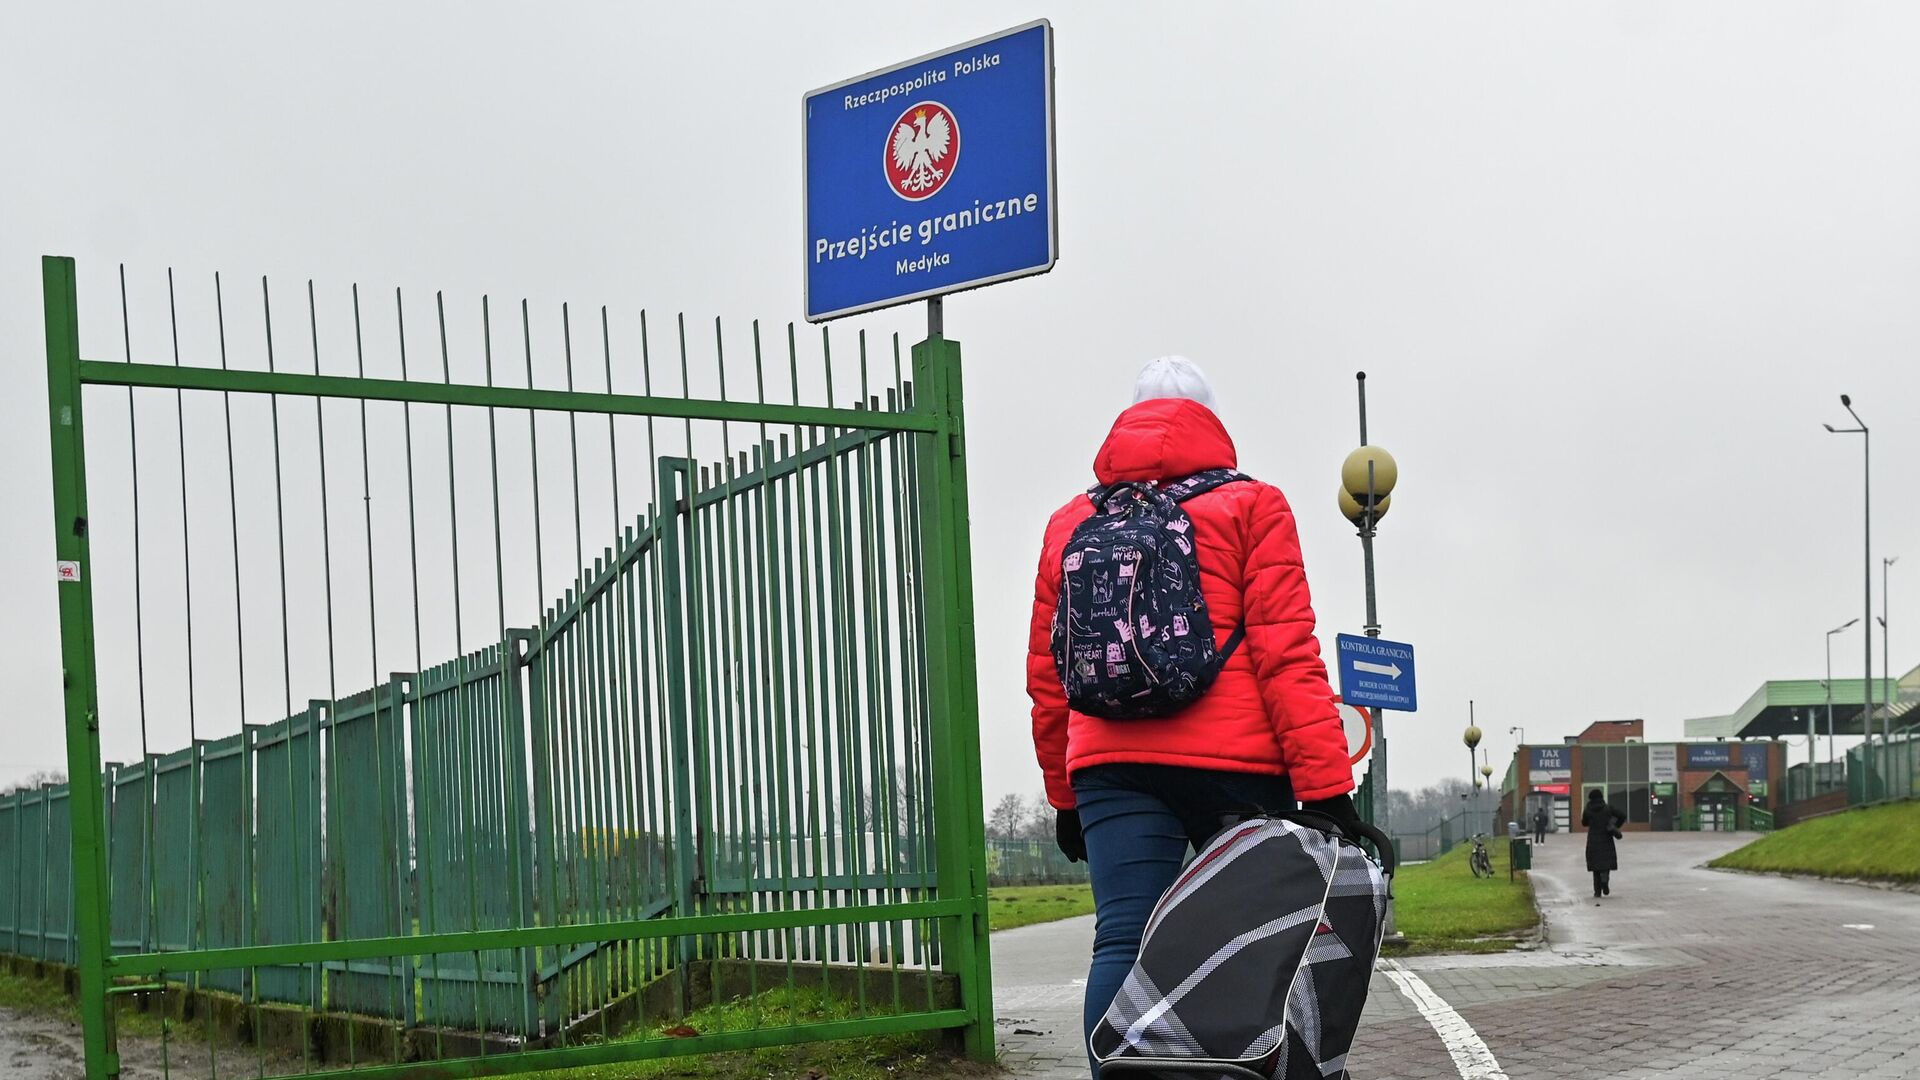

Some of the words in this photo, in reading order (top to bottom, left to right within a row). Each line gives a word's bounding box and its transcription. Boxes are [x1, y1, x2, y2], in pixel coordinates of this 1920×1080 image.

[844, 70, 946, 110] Rzeczpospolita
[954, 54, 1000, 77] Polska
[816, 220, 912, 263] Przejście
[918, 193, 1038, 244] graniczne
[896, 253, 950, 275] Medyka
[1083, 650, 1103, 660] HEART
[1341, 640, 1376, 655] KONTROLA
[1376, 646, 1413, 660] GRANICZNA
[1539, 759, 1561, 768] FREE
[1541, 749, 1559, 758] TAX
